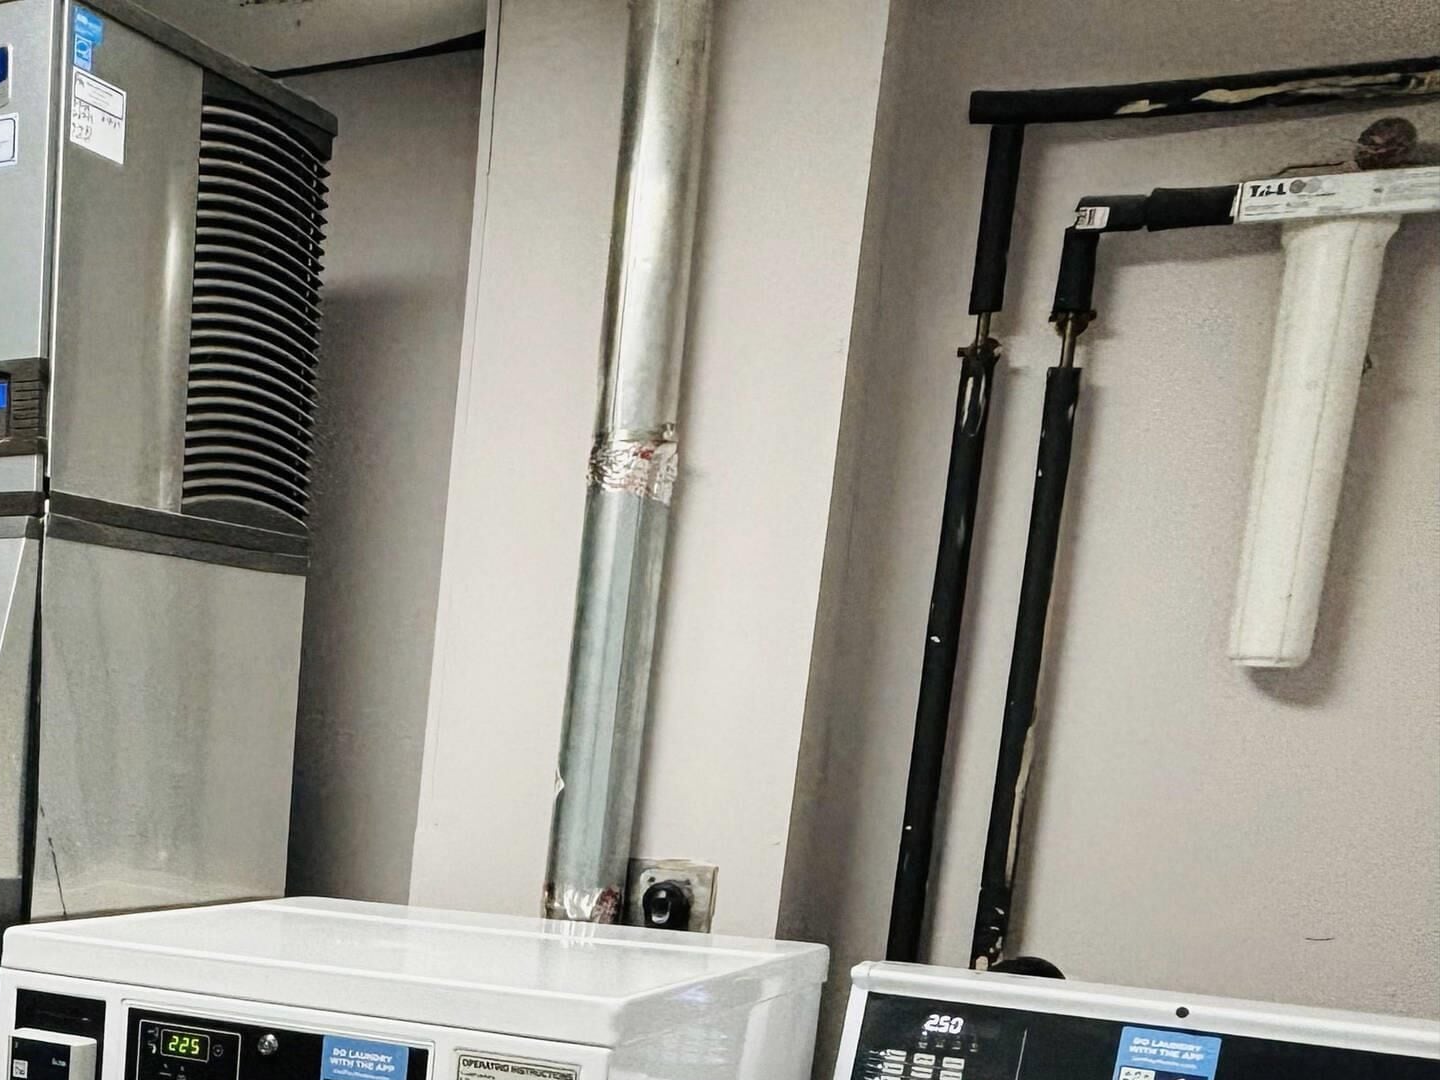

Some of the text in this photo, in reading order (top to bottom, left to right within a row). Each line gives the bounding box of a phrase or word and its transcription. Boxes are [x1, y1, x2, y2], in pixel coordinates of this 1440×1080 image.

[348, 1049, 392, 1063] LAUNDRY
[329, 1057, 395, 1073] WITH THE APP
